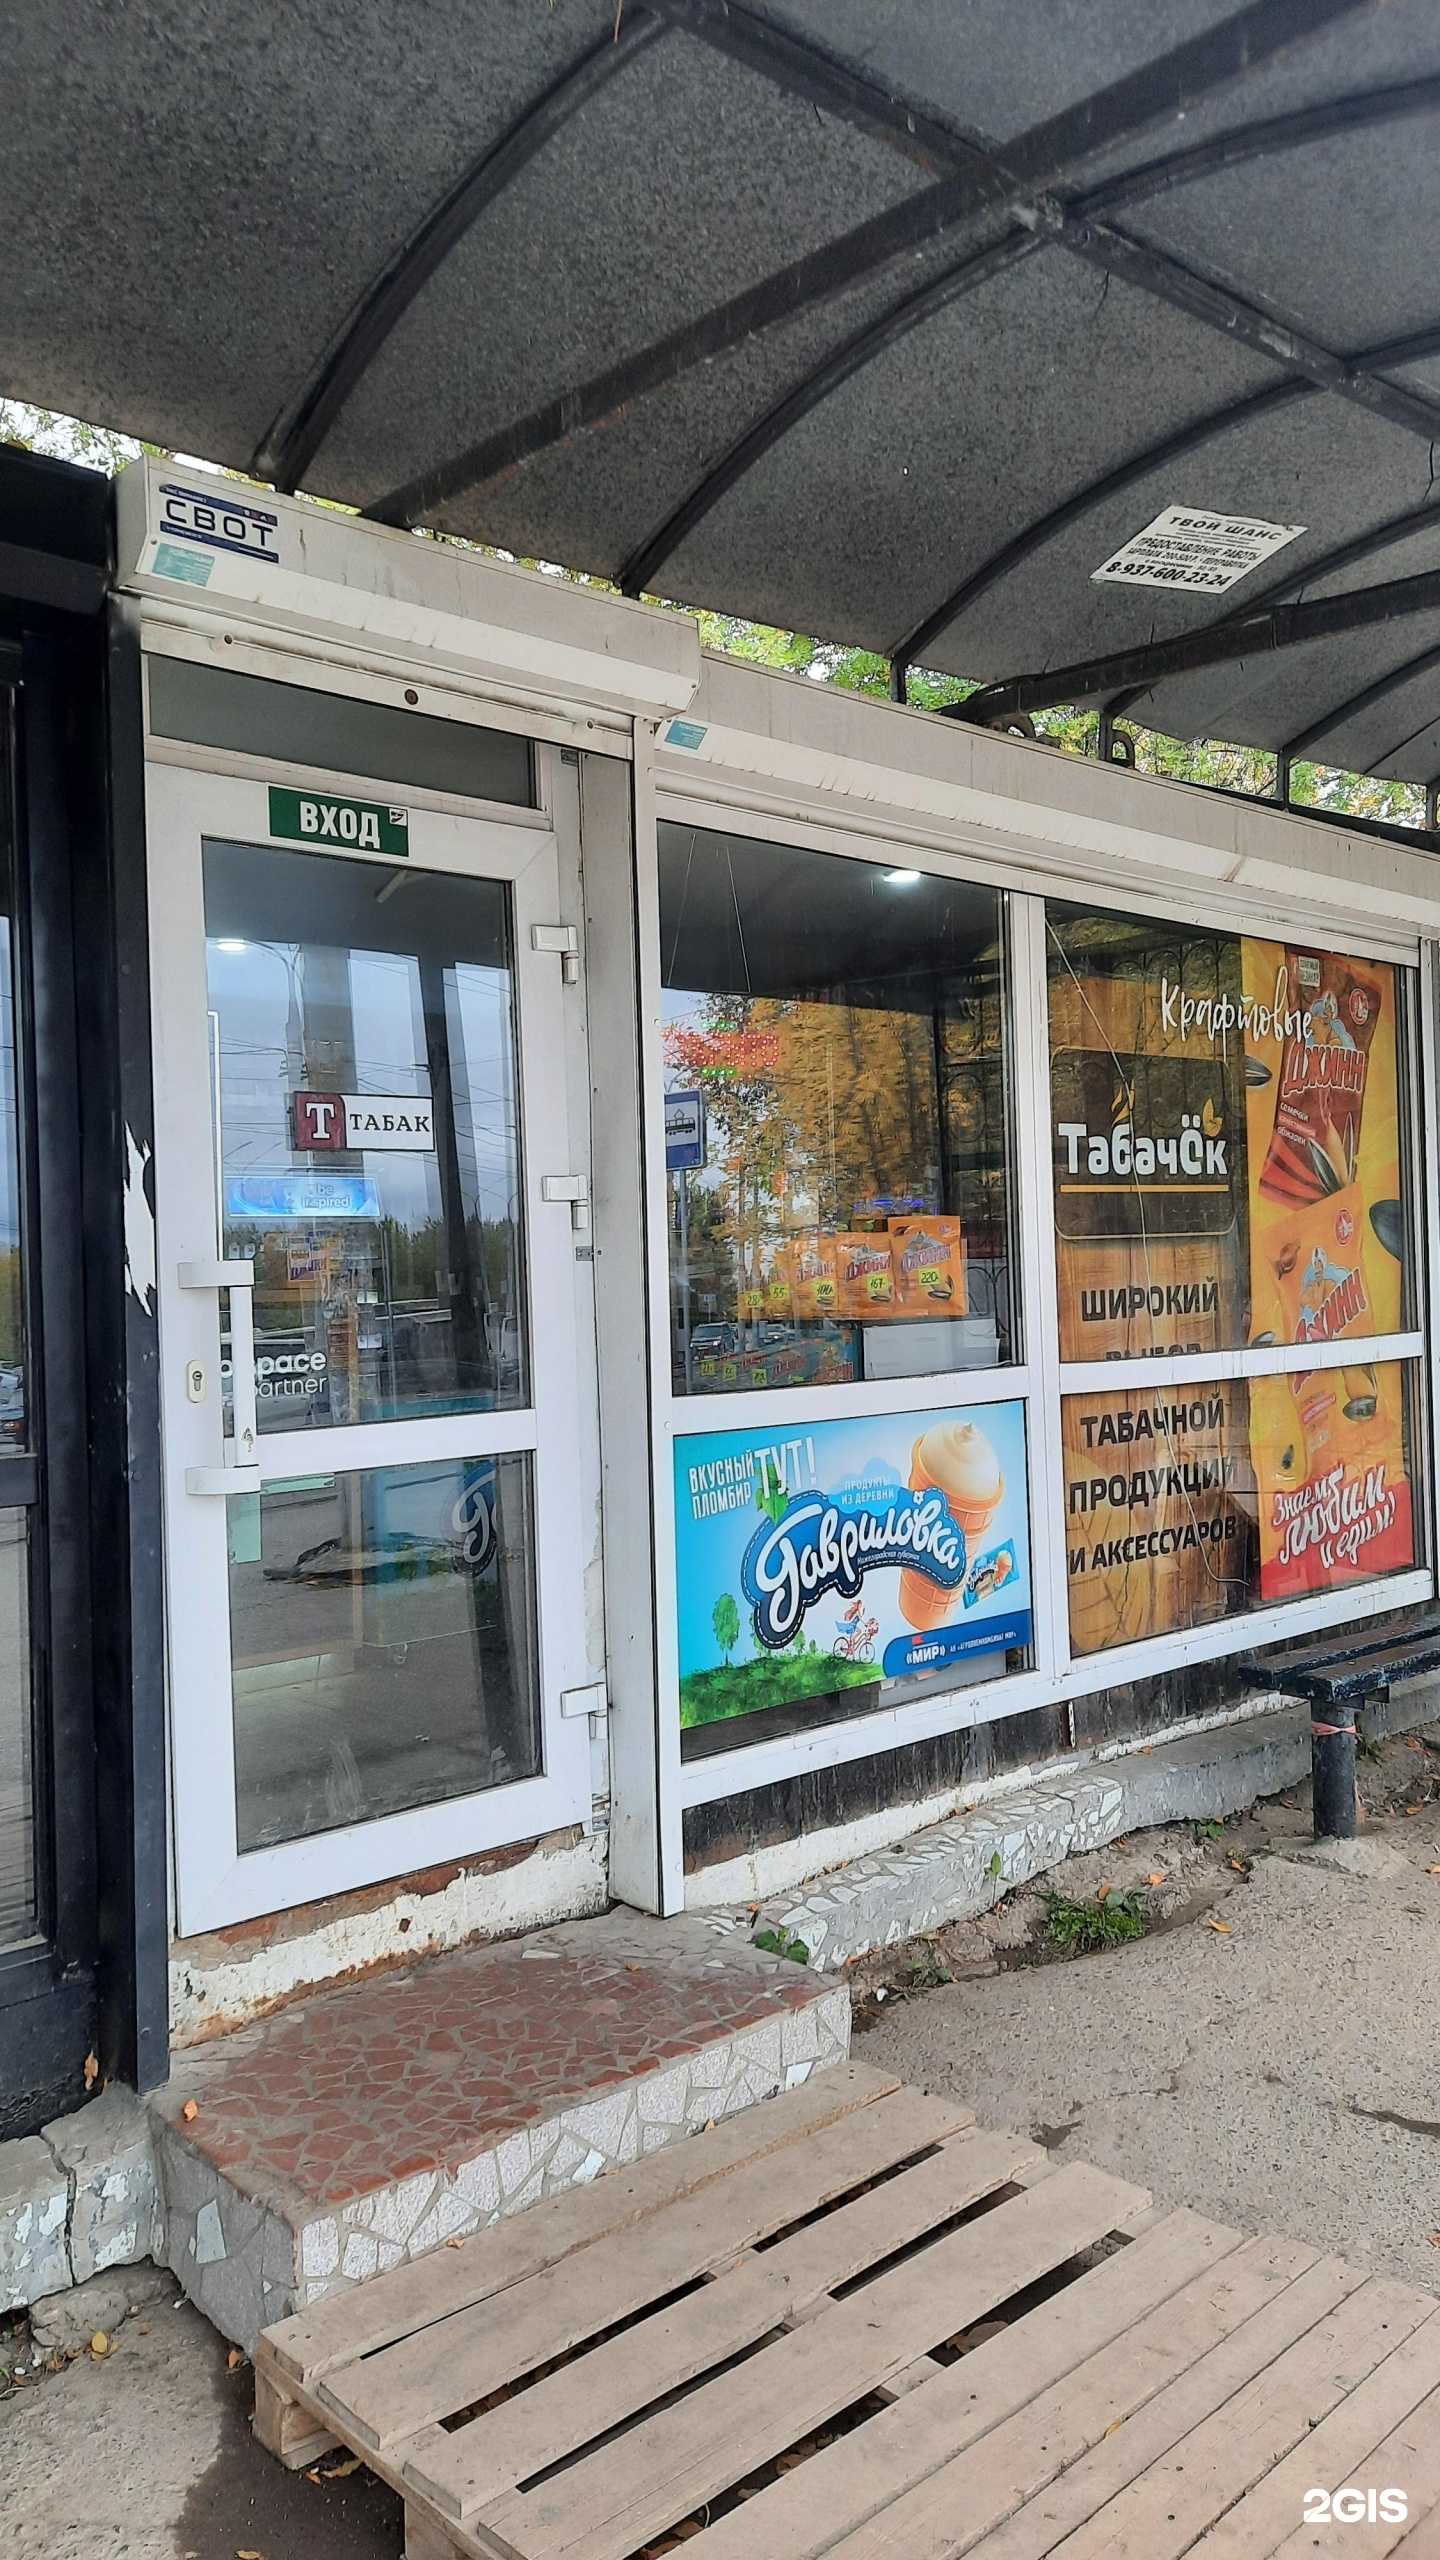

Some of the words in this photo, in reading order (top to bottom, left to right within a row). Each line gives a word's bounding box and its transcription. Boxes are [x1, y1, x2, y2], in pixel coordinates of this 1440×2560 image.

[166, 499, 273, 547] СВОТ
[1224, 524, 1282, 540] ШАНС
[1106, 561, 1233, 587] 8-937-600-23-24
[299, 801, 381, 849] ВХОД
[1161, 966, 1313, 1062] Крафтовые
[1282, 1038, 1366, 1097] ДЖИНН
[349, 1113, 431, 1133] ТАБАК
[1081, 1276, 1220, 1322] ШИРОКИЙ
[256, 1352, 328, 1381] pace
[1080, 1391, 1225, 1448] ТАБАЧНОЙ
[689, 1448, 755, 1493] ВКУСНЫЙ
[754, 1437, 817, 1499] ТУТ!
[1070, 1456, 1234, 1514] ПРОДУКЦИИ
[692, 1482, 752, 1520] ПЛОМБИР
[842, 1495, 853, 1505] ИЗ
[855, 1488, 895, 1504] ДЕРЕВНИ
[755, 1498, 961, 1634] Гавриловка
[1070, 1547, 1086, 1576] И
[1091, 1515, 1237, 1570] АКСЕССУАРОВ
[906, 1645, 946, 1664] «МИР»
